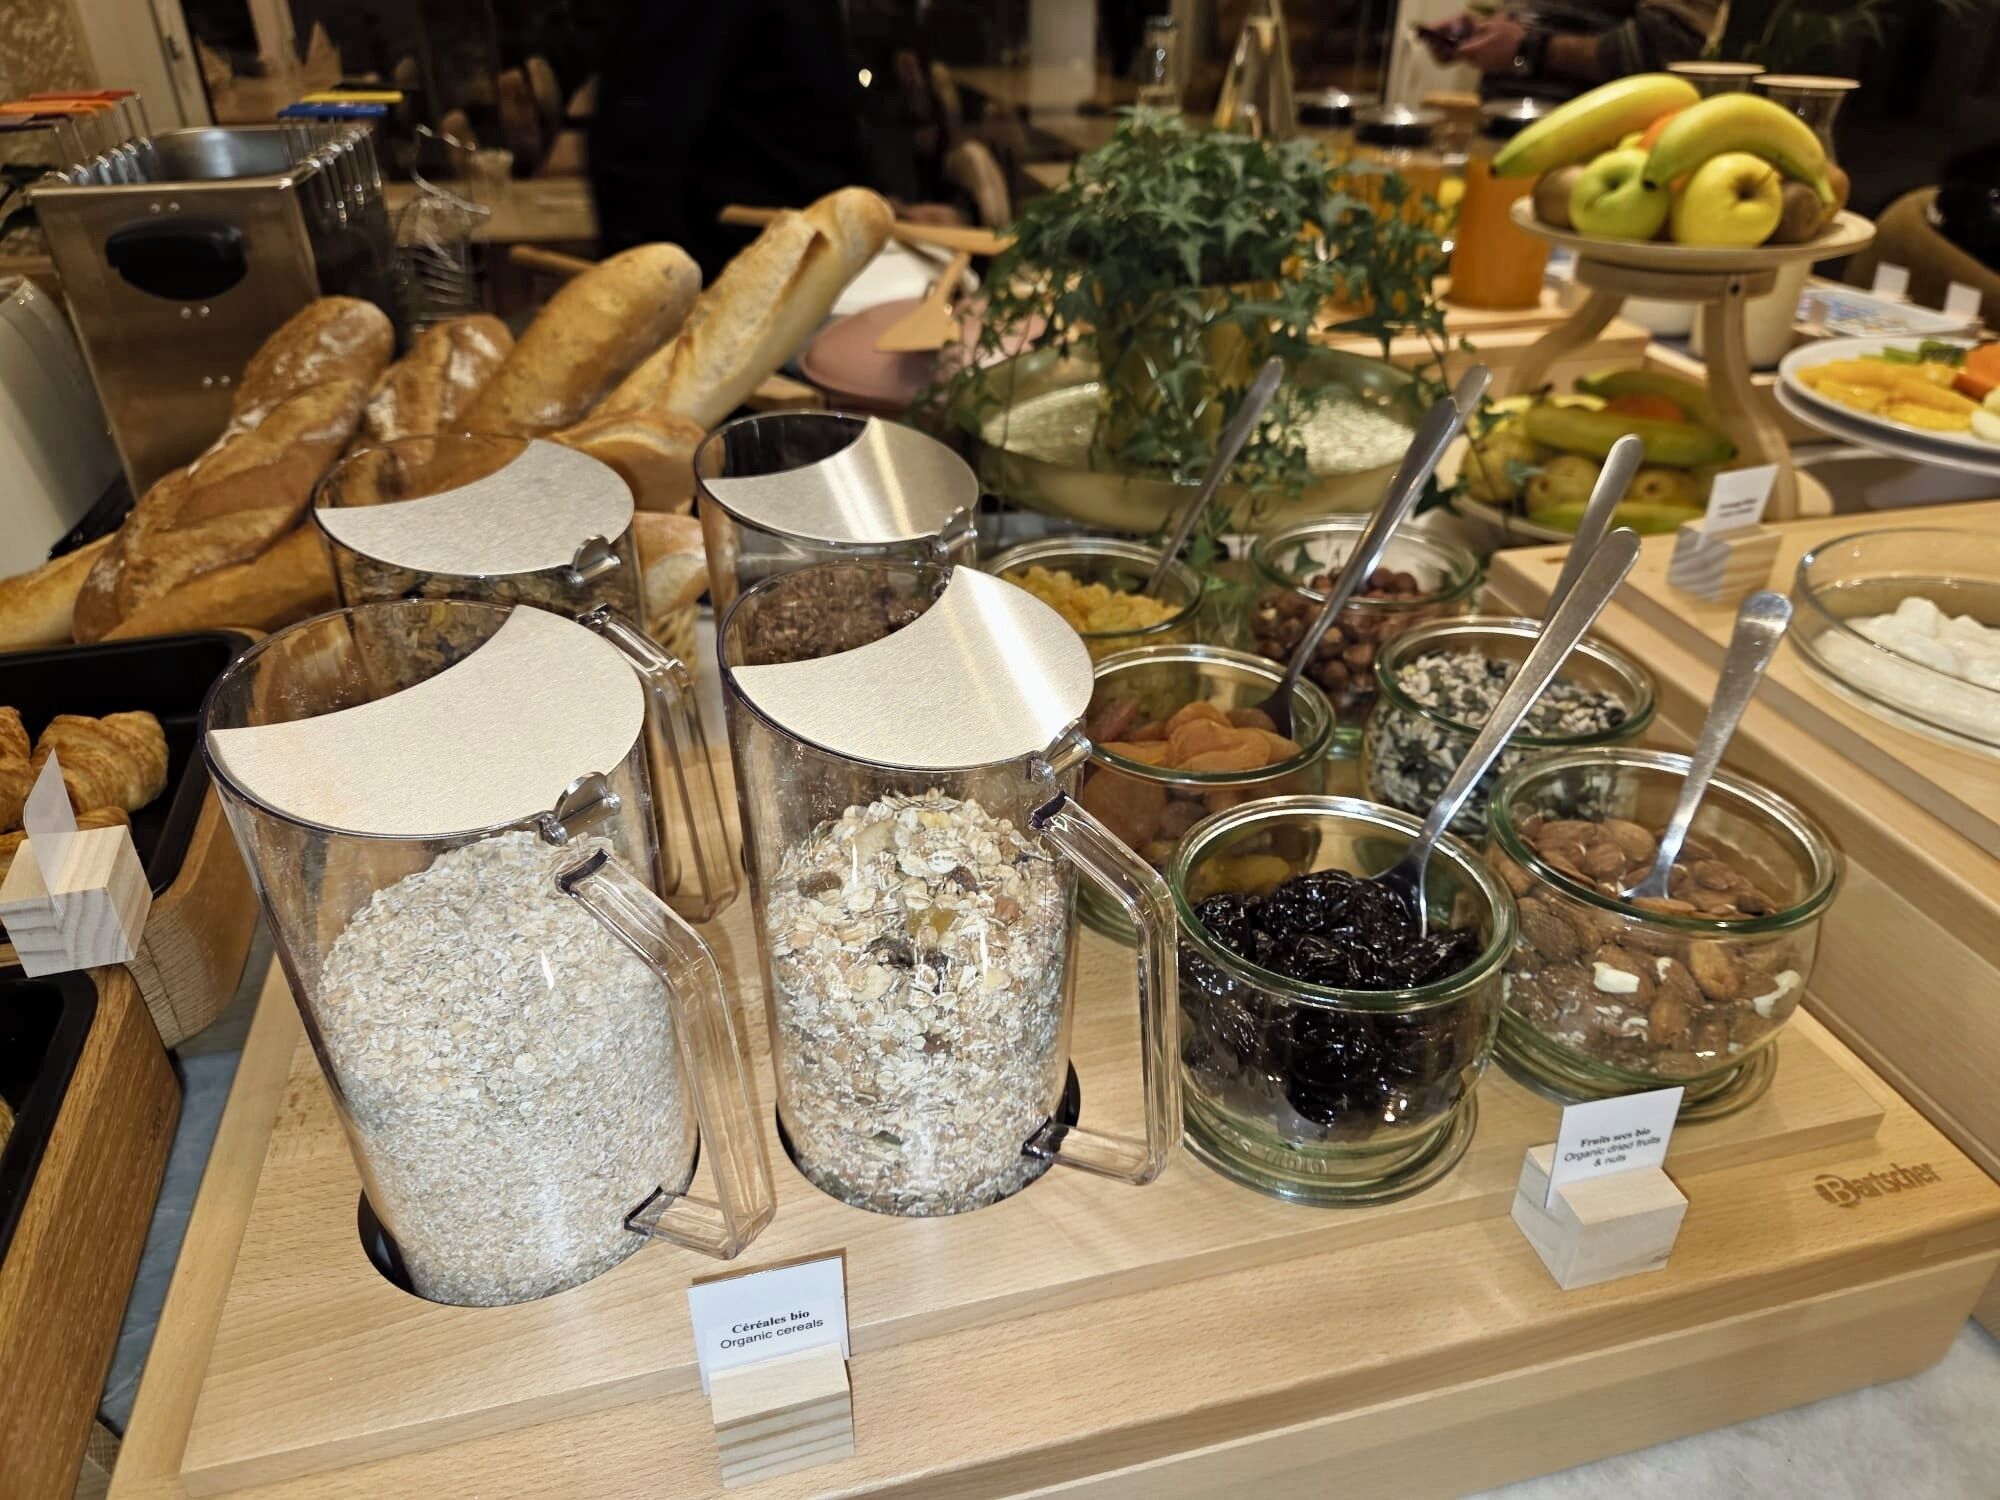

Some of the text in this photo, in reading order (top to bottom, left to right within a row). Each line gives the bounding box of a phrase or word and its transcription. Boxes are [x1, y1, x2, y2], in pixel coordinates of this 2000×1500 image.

[1564, 1136, 1661, 1163] Organic dried fruits
[1581, 1135, 1611, 1148] Fruits
[1635, 1127, 1651, 1137] bio
[1593, 1154, 1627, 1168] & nuts
[720, 1319, 824, 1349] Organic cereals
[731, 1310, 810, 1334] Céréales bio
